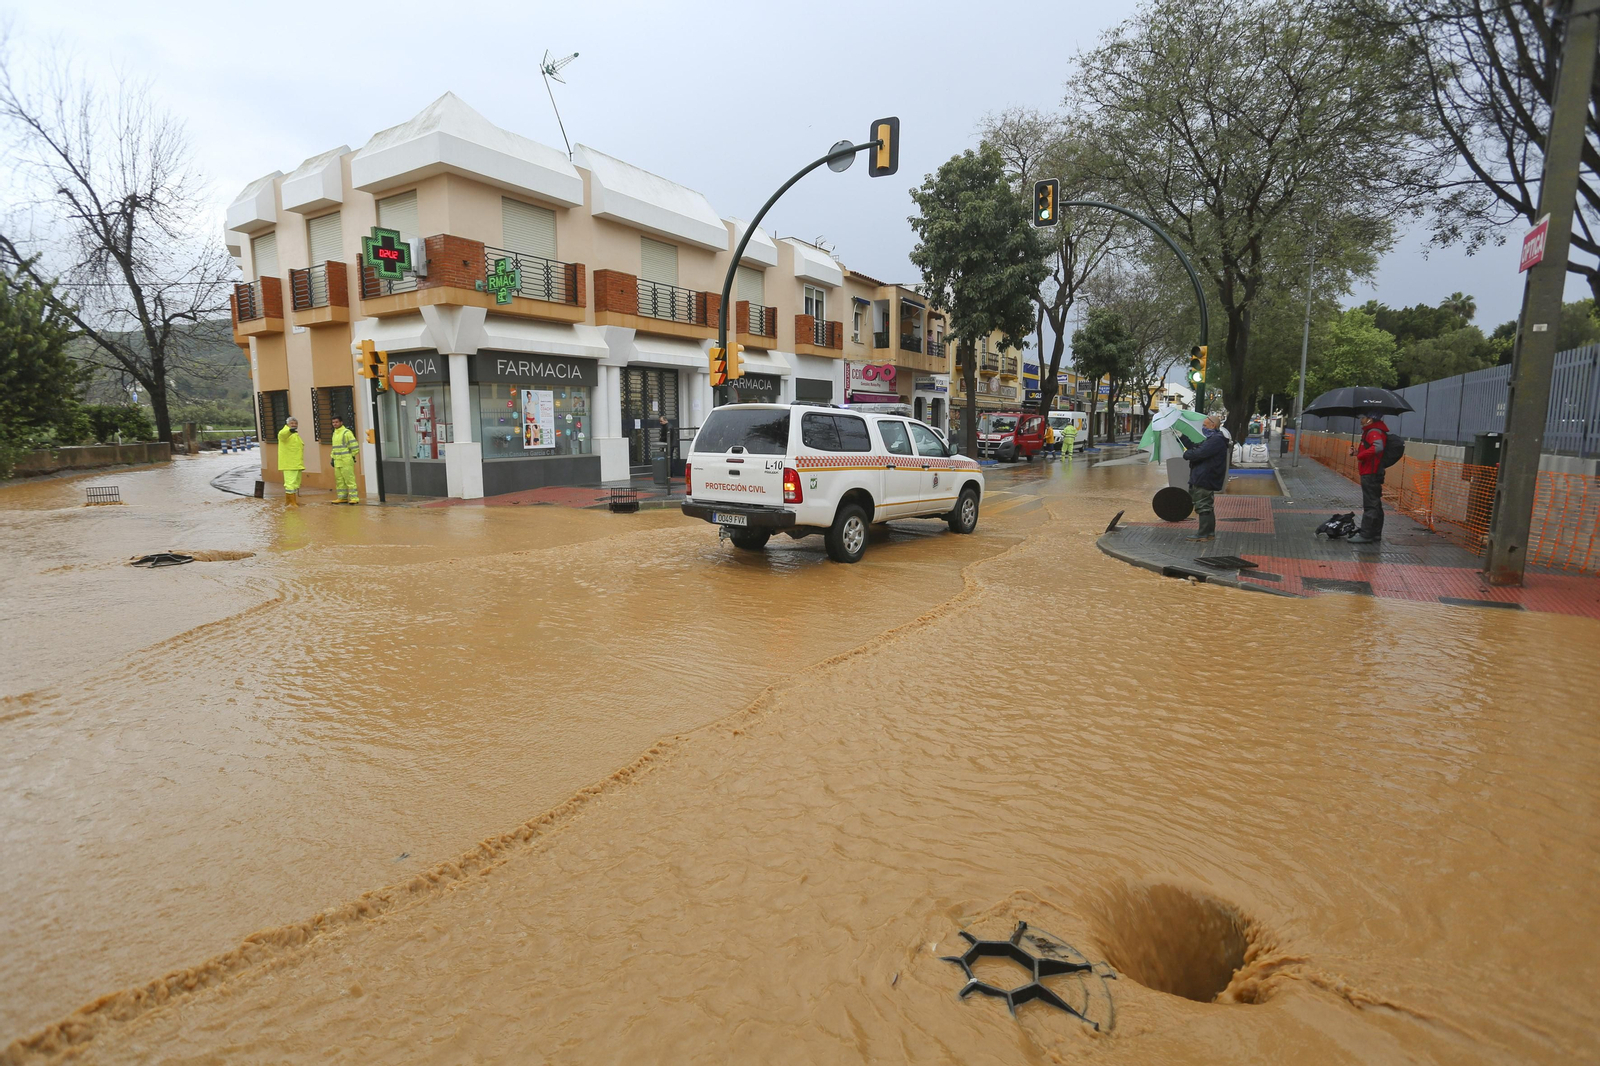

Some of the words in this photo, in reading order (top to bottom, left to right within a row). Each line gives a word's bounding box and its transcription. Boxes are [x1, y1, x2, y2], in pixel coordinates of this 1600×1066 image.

[497, 359, 582, 379] FARMACIA
[765, 460, 783, 470] L-10
[705, 482, 747, 492] PROTECCIÓN
[748, 485, 766, 494] CIVIL
[718, 514, 733, 523] 0049
[734, 515, 745, 524] FVX
